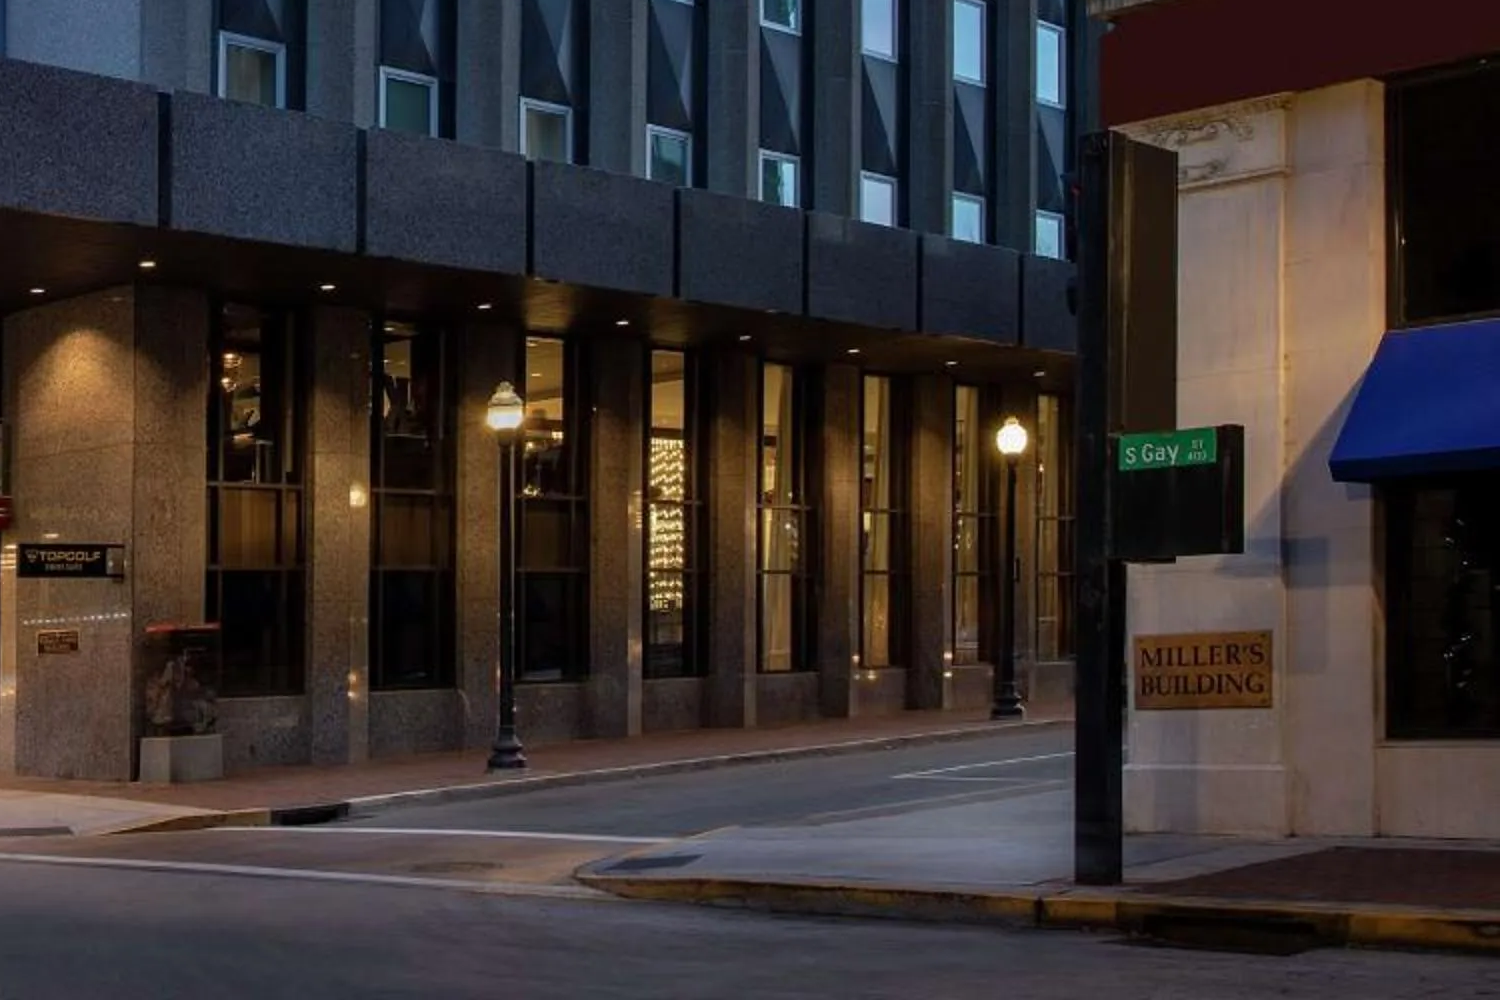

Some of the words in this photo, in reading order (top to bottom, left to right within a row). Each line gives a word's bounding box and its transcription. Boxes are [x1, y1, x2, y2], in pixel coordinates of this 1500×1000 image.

[1125, 446, 1138, 465] S
[1141, 442, 1180, 466] Gay
[40, 550, 101, 562] TOPGOLF
[1140, 643, 1266, 669] MILLER'S
[1141, 672, 1265, 697] BUILDING
